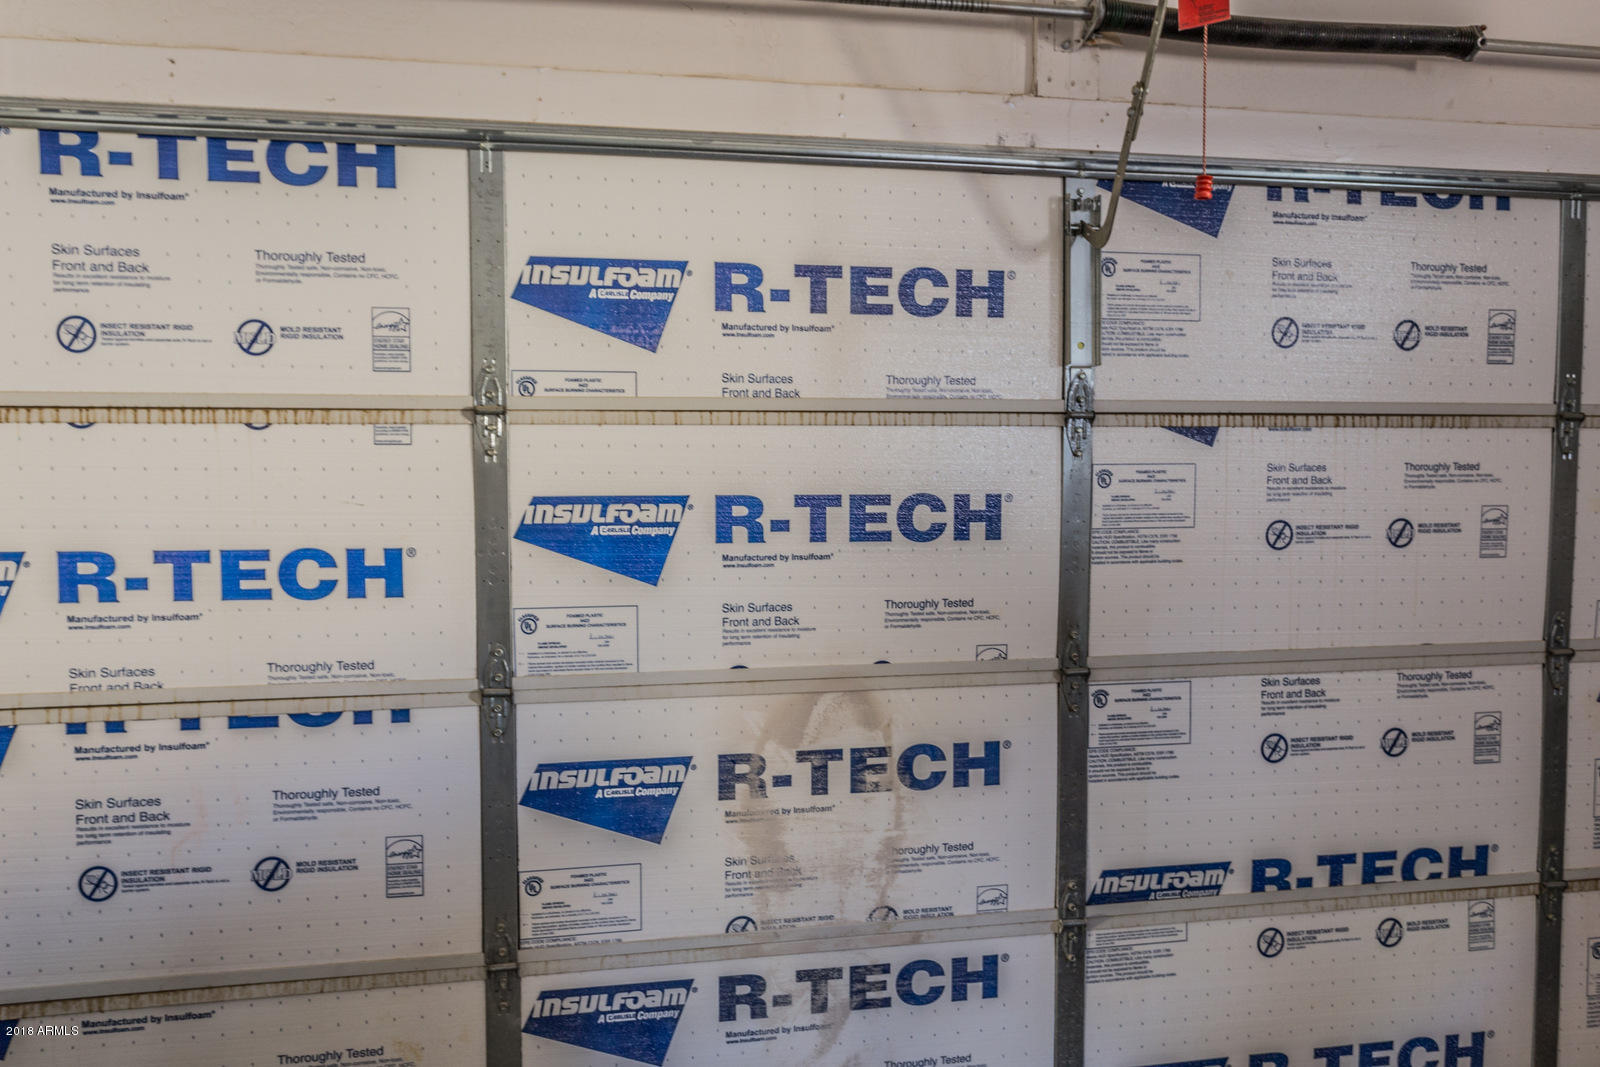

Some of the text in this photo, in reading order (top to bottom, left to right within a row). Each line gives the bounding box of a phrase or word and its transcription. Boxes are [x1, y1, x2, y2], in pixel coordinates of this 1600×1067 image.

[48, 187, 118, 198] Manufactured
[121, 190, 132, 200] by
[51, 243, 141, 257] Skin Surfaces
[255, 250, 366, 264] Thoroughly Tested
[52, 260, 149, 273] Front and Back
[1411, 261, 1487, 274] Thoroughly Tested
[630, 289, 675, 302] Company
[721, 323, 778, 331] Manufactured
[780, 324, 789, 333] by
[722, 373, 793, 384] Skin Surfaces
[886, 375, 976, 387] Thoroughly Tested
[722, 388, 800, 399] Front and Back
[1267, 463, 1327, 472] Skin Surfaces
[1404, 462, 1480, 473] Thoroughly Tested
[1267, 475, 1333, 485] Front and Back
[631, 526, 676, 537] Company
[722, 554, 778, 562] Manufactured
[779, 554, 790, 563] by
[722, 602, 793, 614] Skin Surfaces
[884, 598, 975, 611] Thoroughly Tested
[66, 615, 134, 623] Manufactured
[137, 614, 148, 624] by
[722, 616, 800, 627] Front and Back
[69, 667, 156, 679] Skin Surfaces
[267, 660, 375, 674] Thoroughly Tested
[1261, 676, 1321, 688] Skin Surfaces
[1397, 670, 1473, 682] Thoroughly Tested
[1261, 689, 1327, 700] Front and Back
[74, 745, 142, 754] Manufactured
[144, 744, 156, 753] by
[272, 786, 381, 801] Thoroughly Tested
[635, 786, 680, 797] Company
[75, 797, 161, 810] Skin Surfaces
[75, 811, 171, 825] Front and Back
[942, 841, 974, 852] Tested
[724, 857, 747, 867] Skin
[724, 870, 752, 880] Front
[637, 1009, 680, 1021] Company
[81, 1016, 148, 1029] Manufactured
[150, 1015, 162, 1024] by
[725, 1027, 780, 1039] Manufactured
[781, 1026, 793, 1035] by
[277, 1046, 385, 1065] Thoroughly Tested
[883, 1053, 972, 1067] Thoroughly Tested
